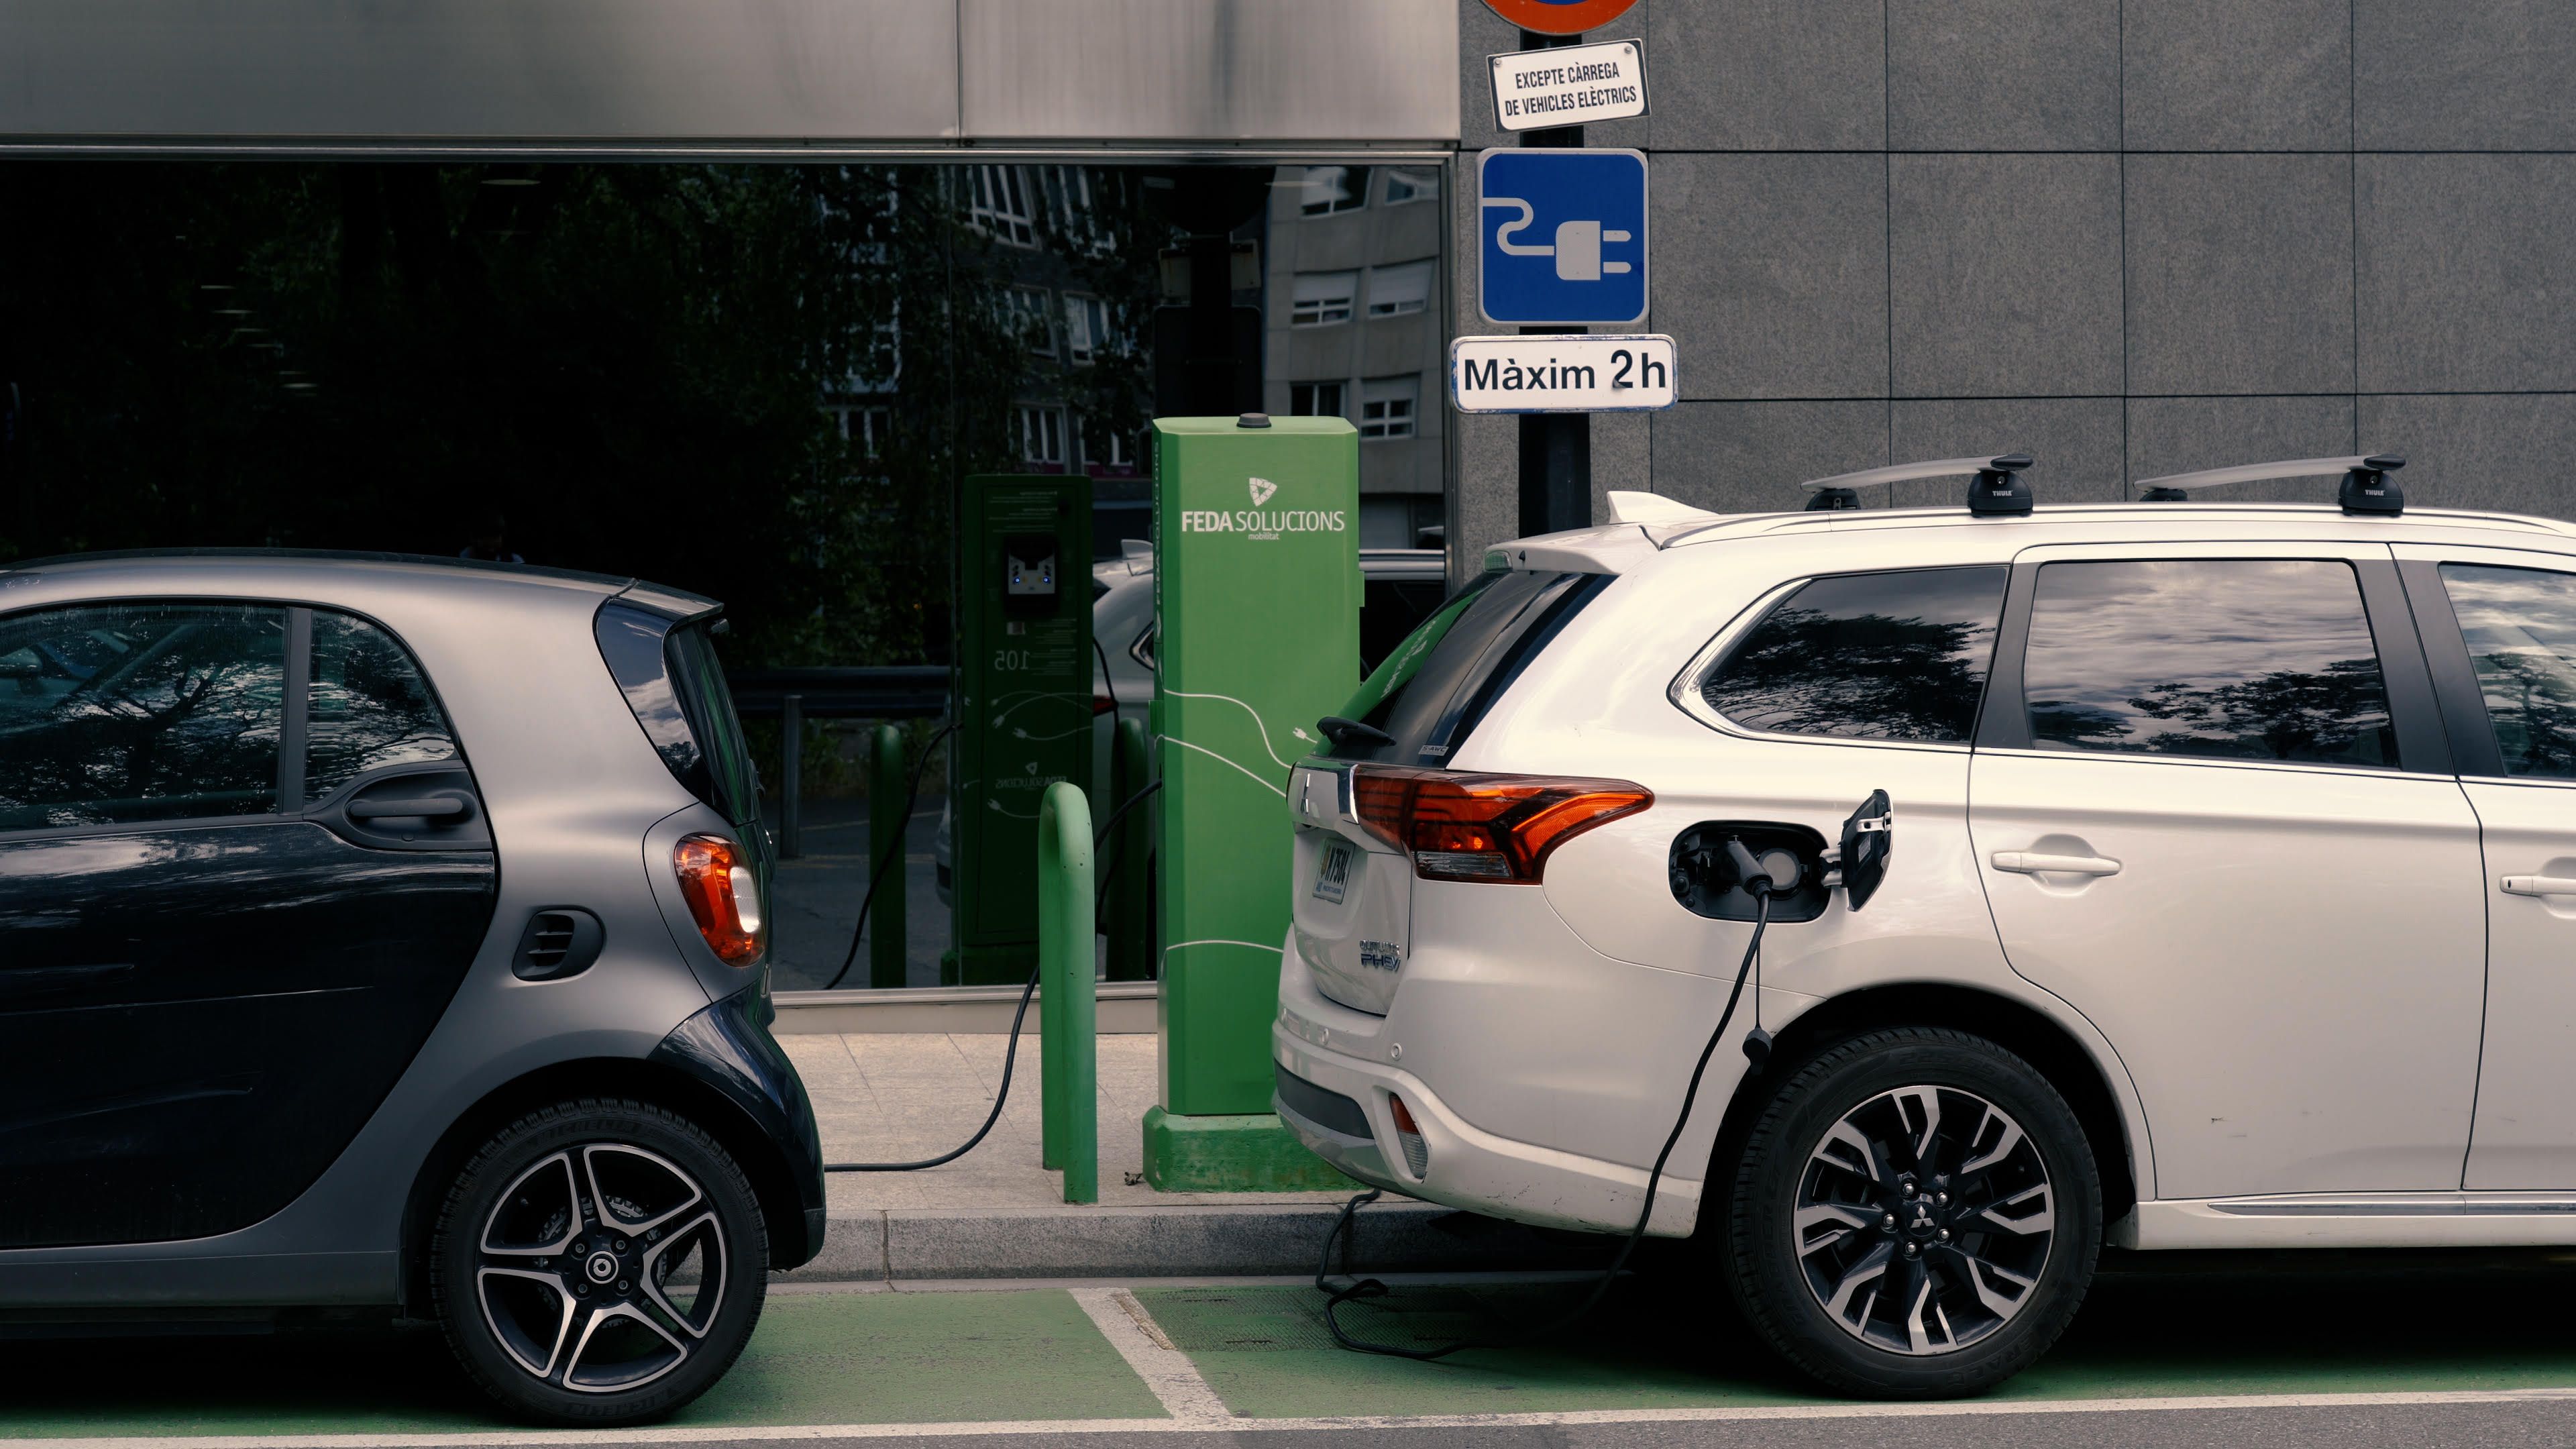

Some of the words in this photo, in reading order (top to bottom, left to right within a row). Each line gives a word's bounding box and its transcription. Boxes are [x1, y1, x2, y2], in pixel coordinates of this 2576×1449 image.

[1515, 68, 1565, 89] EXCEPTE
[1568, 62, 1619, 84] CÀRREGA
[1505, 99, 1520, 117] DE
[1522, 93, 1575, 113] VEHICLES
[1578, 86, 1637, 109] ELÈCTRICS
[1464, 358, 1595, 390] Màxim
[1611, 349, 1666, 388] 2h
[1235, 511, 1346, 532] SOLUCIONS
[1248, 532, 1280, 541] mobilitat
[1360, 953, 1401, 972] PHEV
